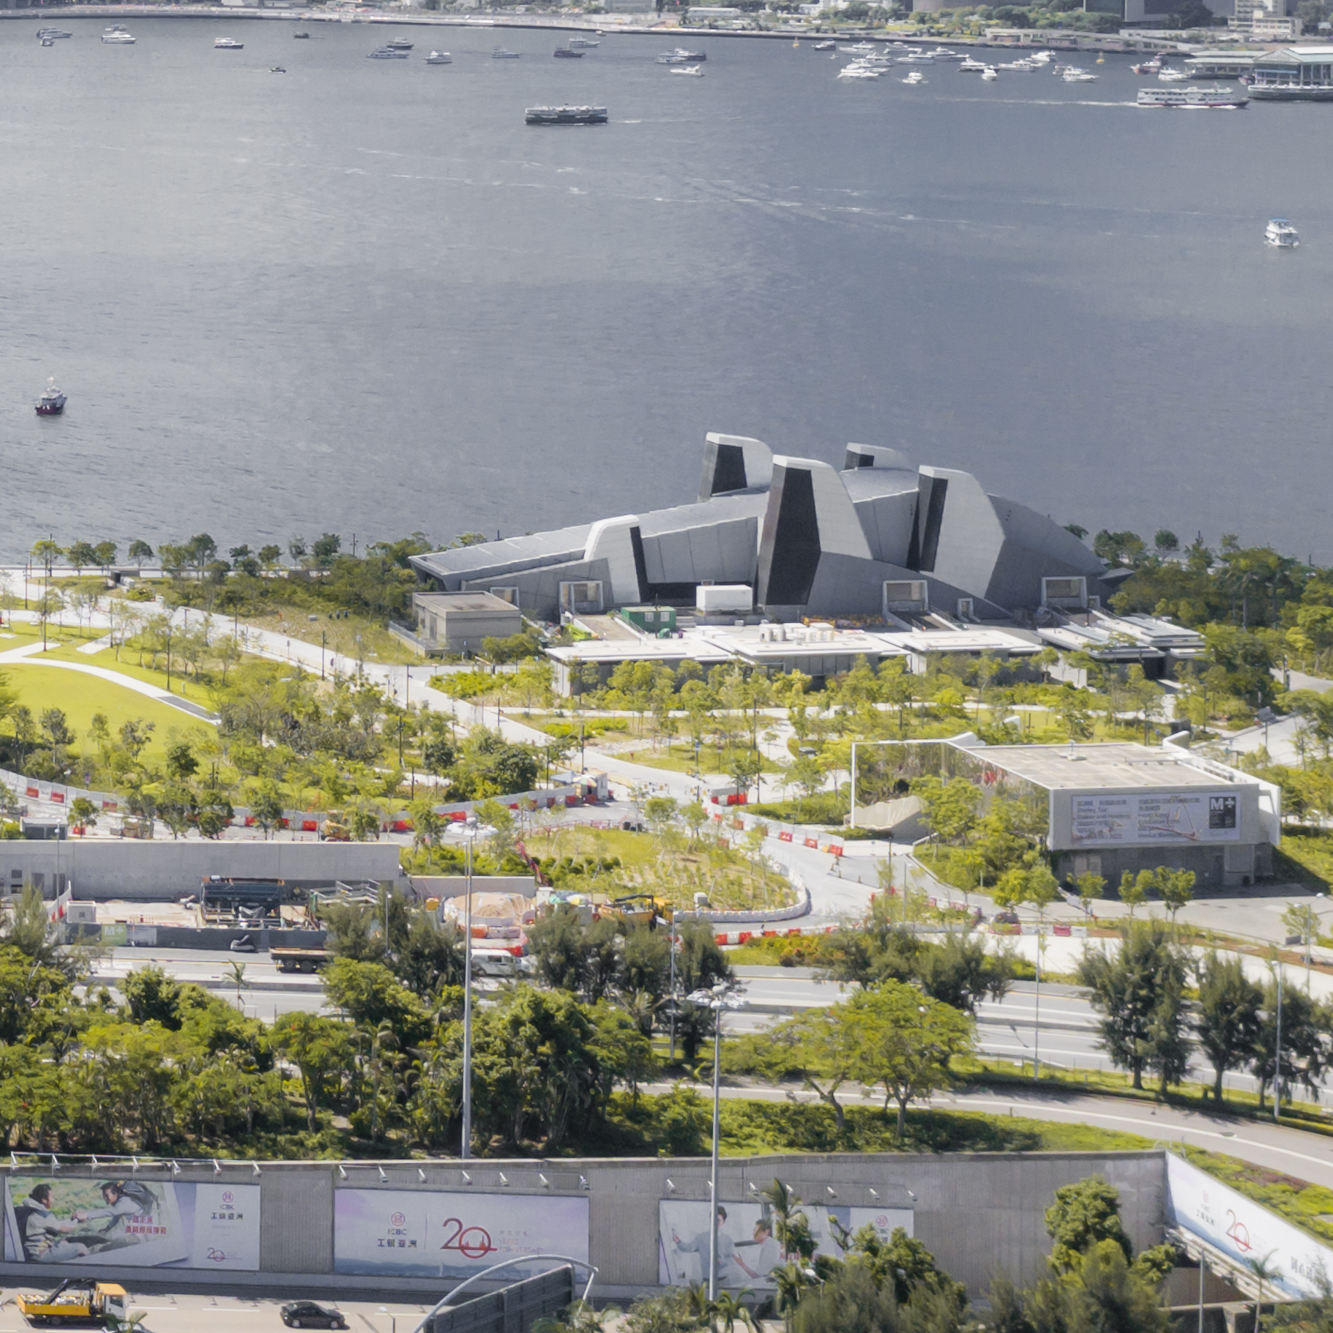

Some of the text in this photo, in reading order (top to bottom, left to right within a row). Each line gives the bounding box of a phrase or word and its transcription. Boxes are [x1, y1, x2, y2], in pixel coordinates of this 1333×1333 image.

[1210, 797, 1235, 811] M+
[387, 1228, 408, 1236] ICBC
[440, 1218, 495, 1259] 20
